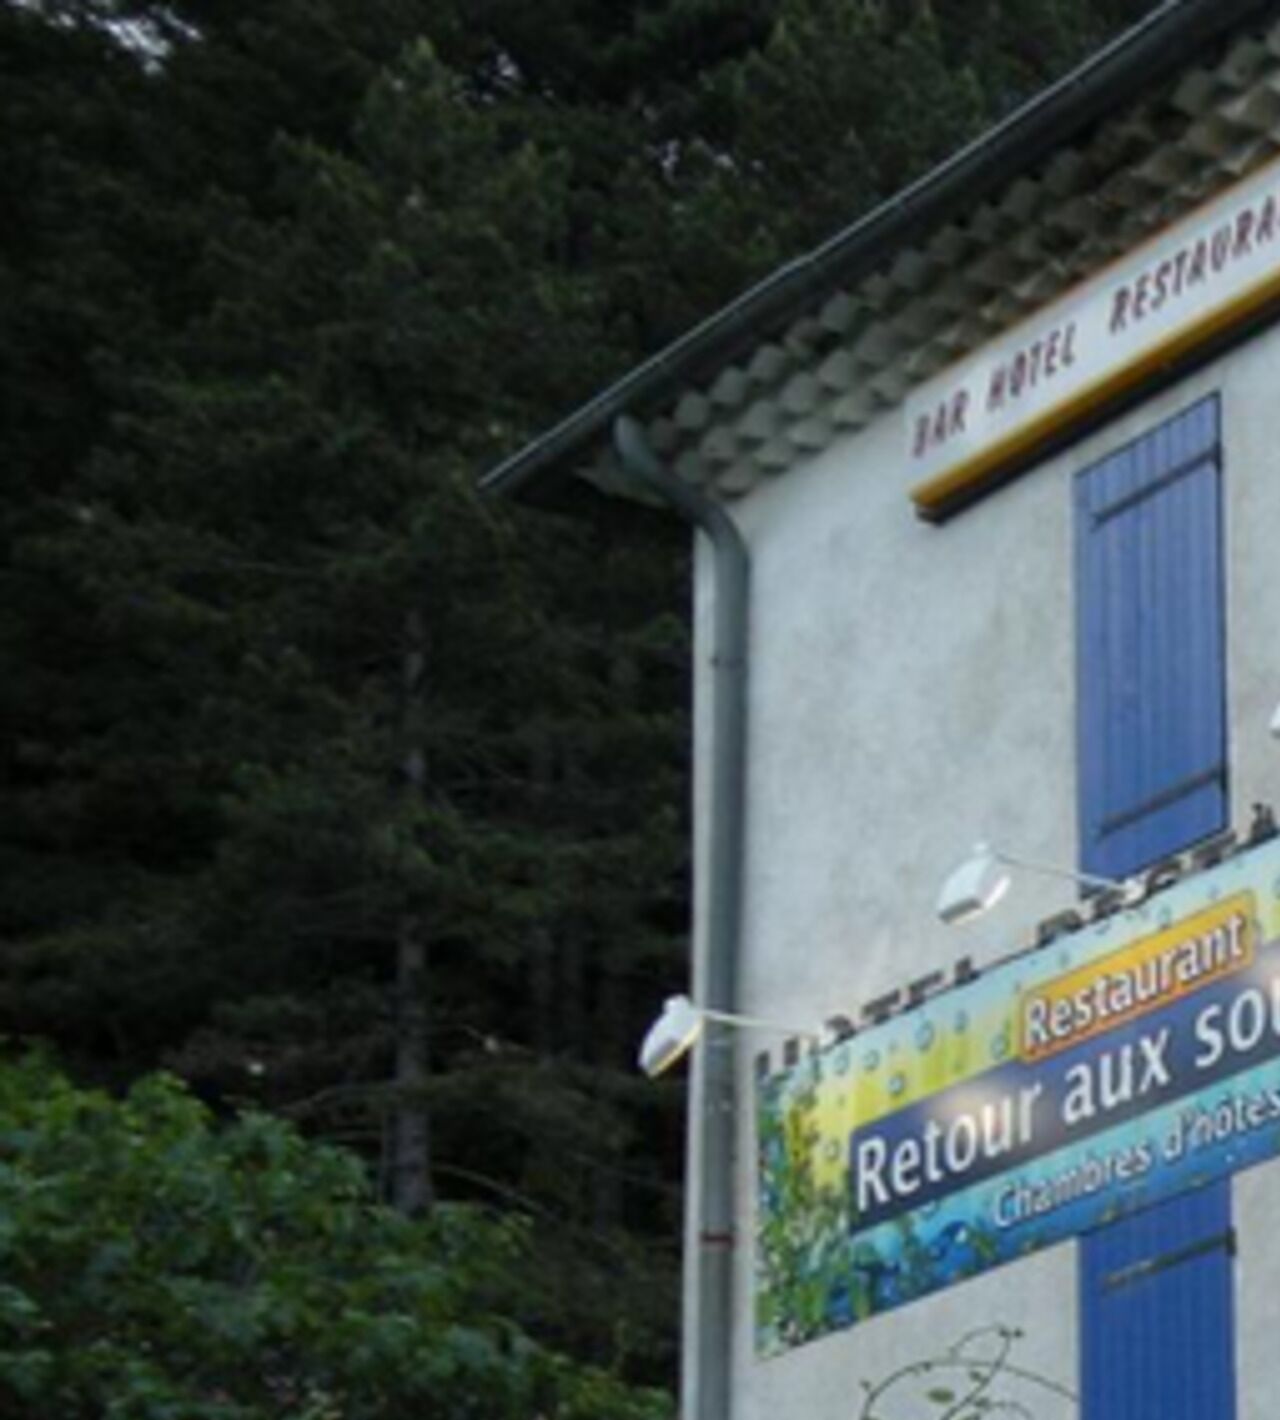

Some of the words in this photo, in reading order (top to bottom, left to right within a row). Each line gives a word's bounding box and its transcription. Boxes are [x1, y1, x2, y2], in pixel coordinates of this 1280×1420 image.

[911, 390, 968, 458] BAR
[986, 324, 1075, 411] HOTEL
[1022, 912, 1246, 1050] Restaurant
[856, 1080, 1042, 1212] Retour
[1062, 1027, 1172, 1125] aux
[994, 1137, 1154, 1228] Chambres
